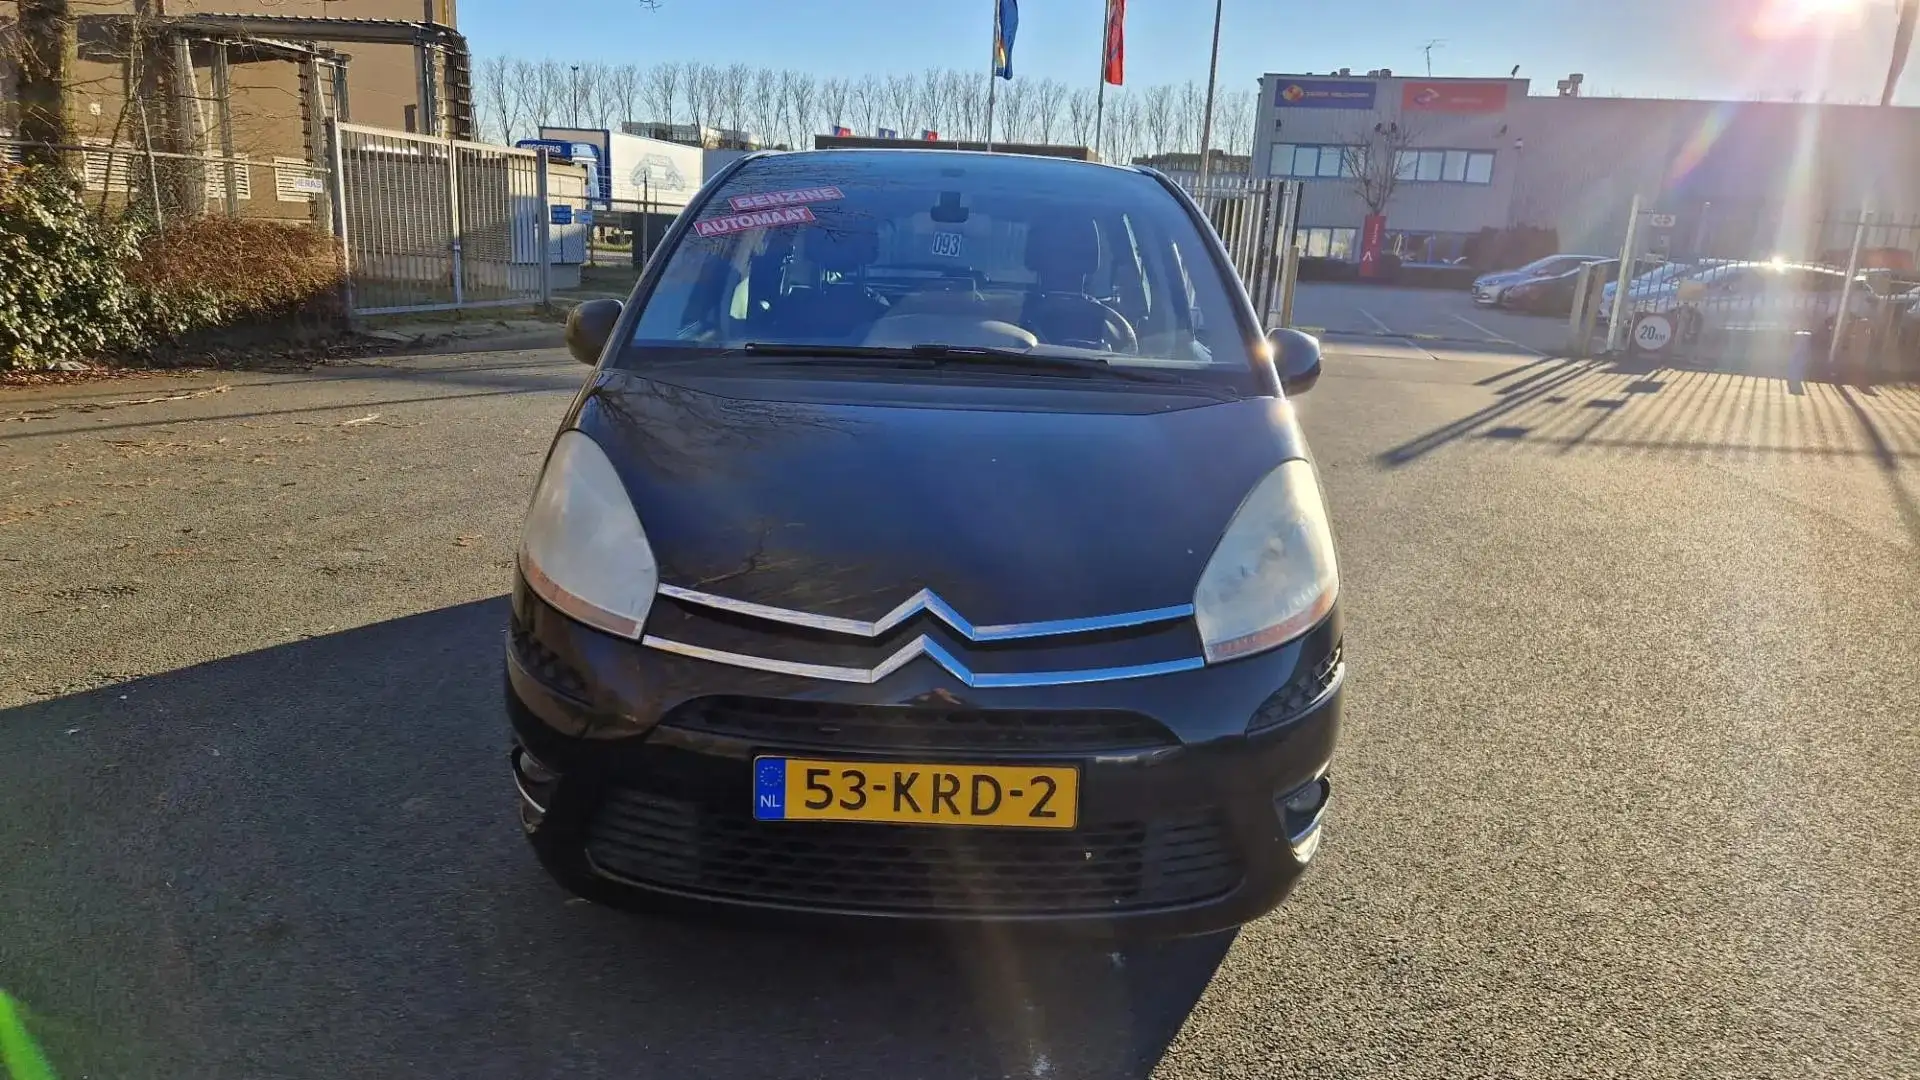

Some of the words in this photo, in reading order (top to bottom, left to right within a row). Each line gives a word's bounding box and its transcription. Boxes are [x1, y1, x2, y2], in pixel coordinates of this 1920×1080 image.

[737, 188, 837, 208] BENZINE
[701, 208, 806, 235] AUTOMAAT
[933, 233, 960, 256] 093
[760, 794, 782, 809] NL
[803, 767, 1058, 818] 53-KRD-2
